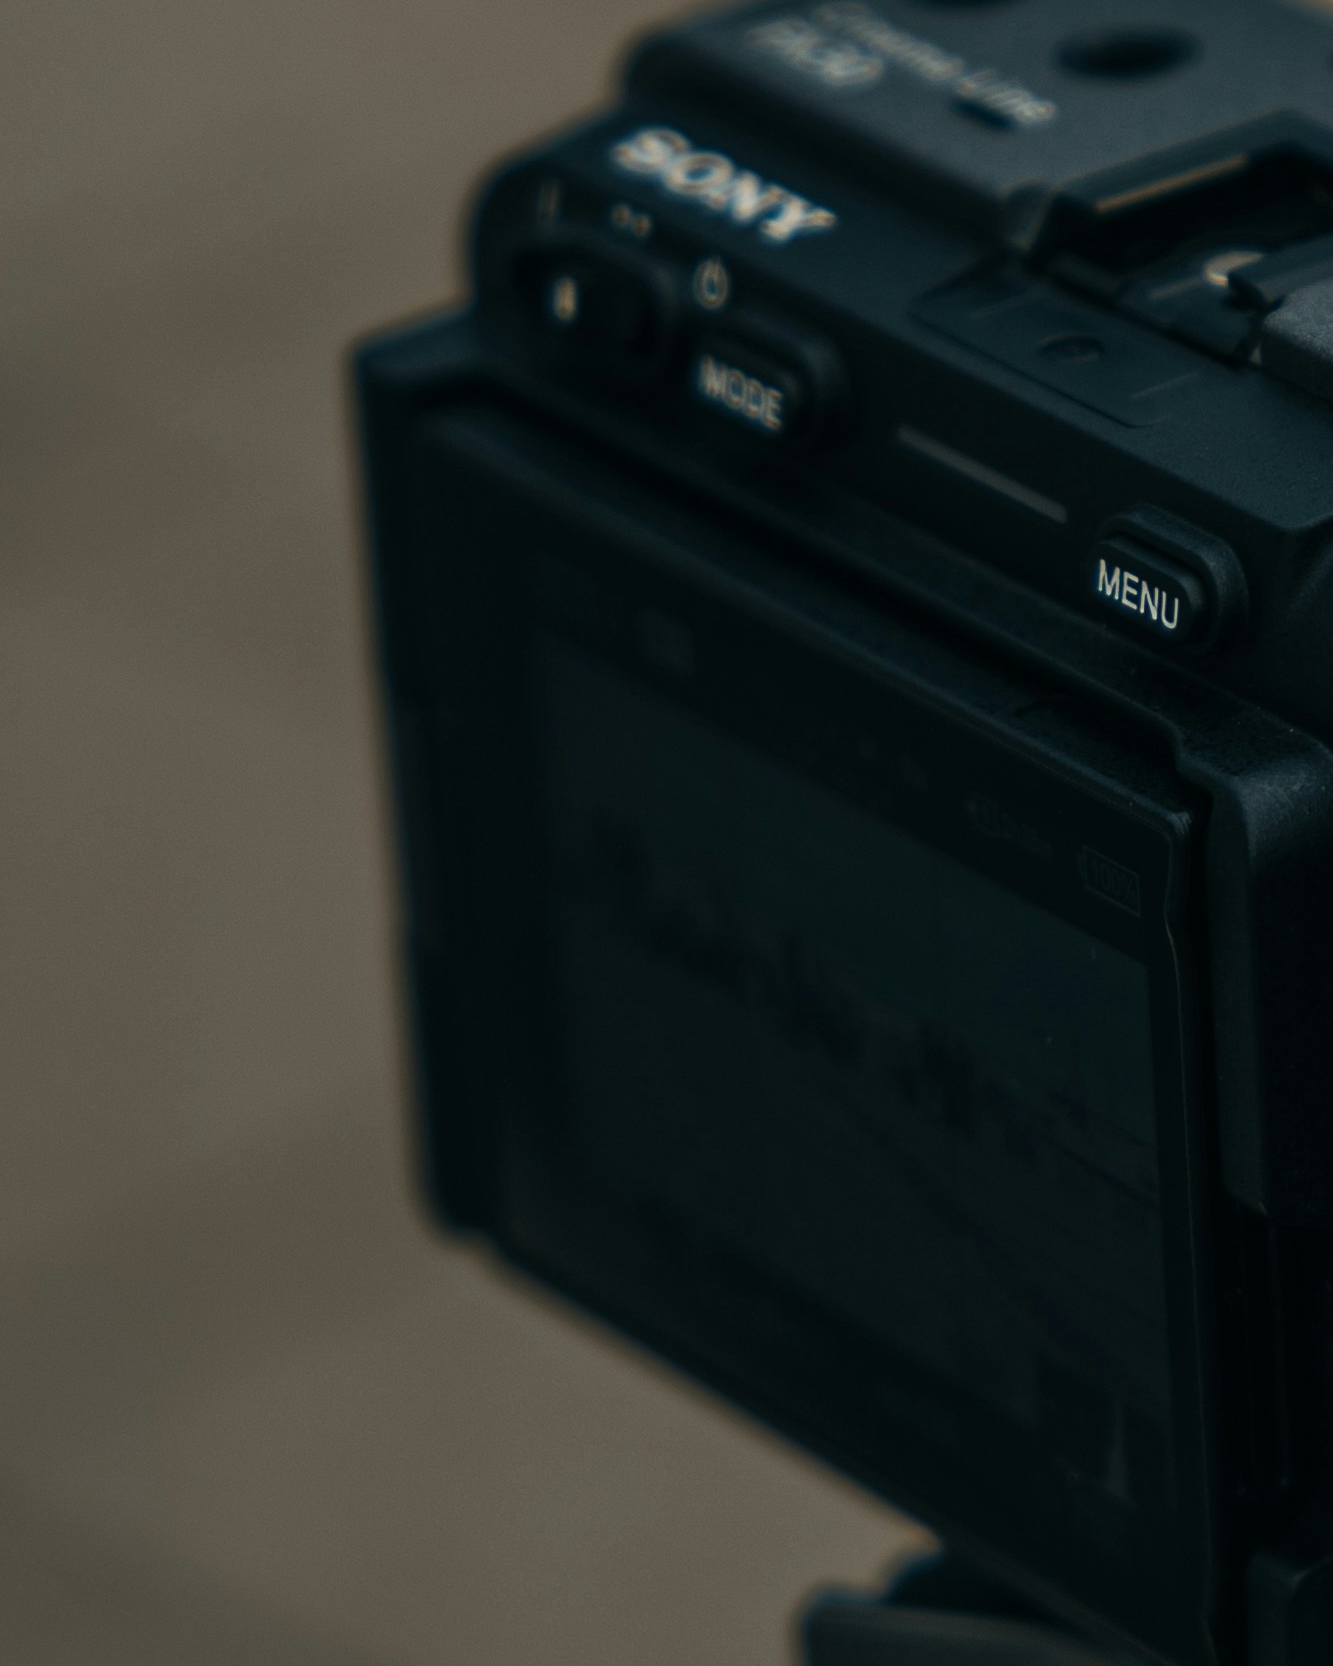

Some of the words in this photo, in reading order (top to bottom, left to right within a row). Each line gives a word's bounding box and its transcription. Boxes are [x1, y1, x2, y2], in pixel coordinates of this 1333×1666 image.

[609, 124, 838, 244] SONY
[698, 353, 785, 434] MODE
[1097, 558, 1181, 630] MENU
